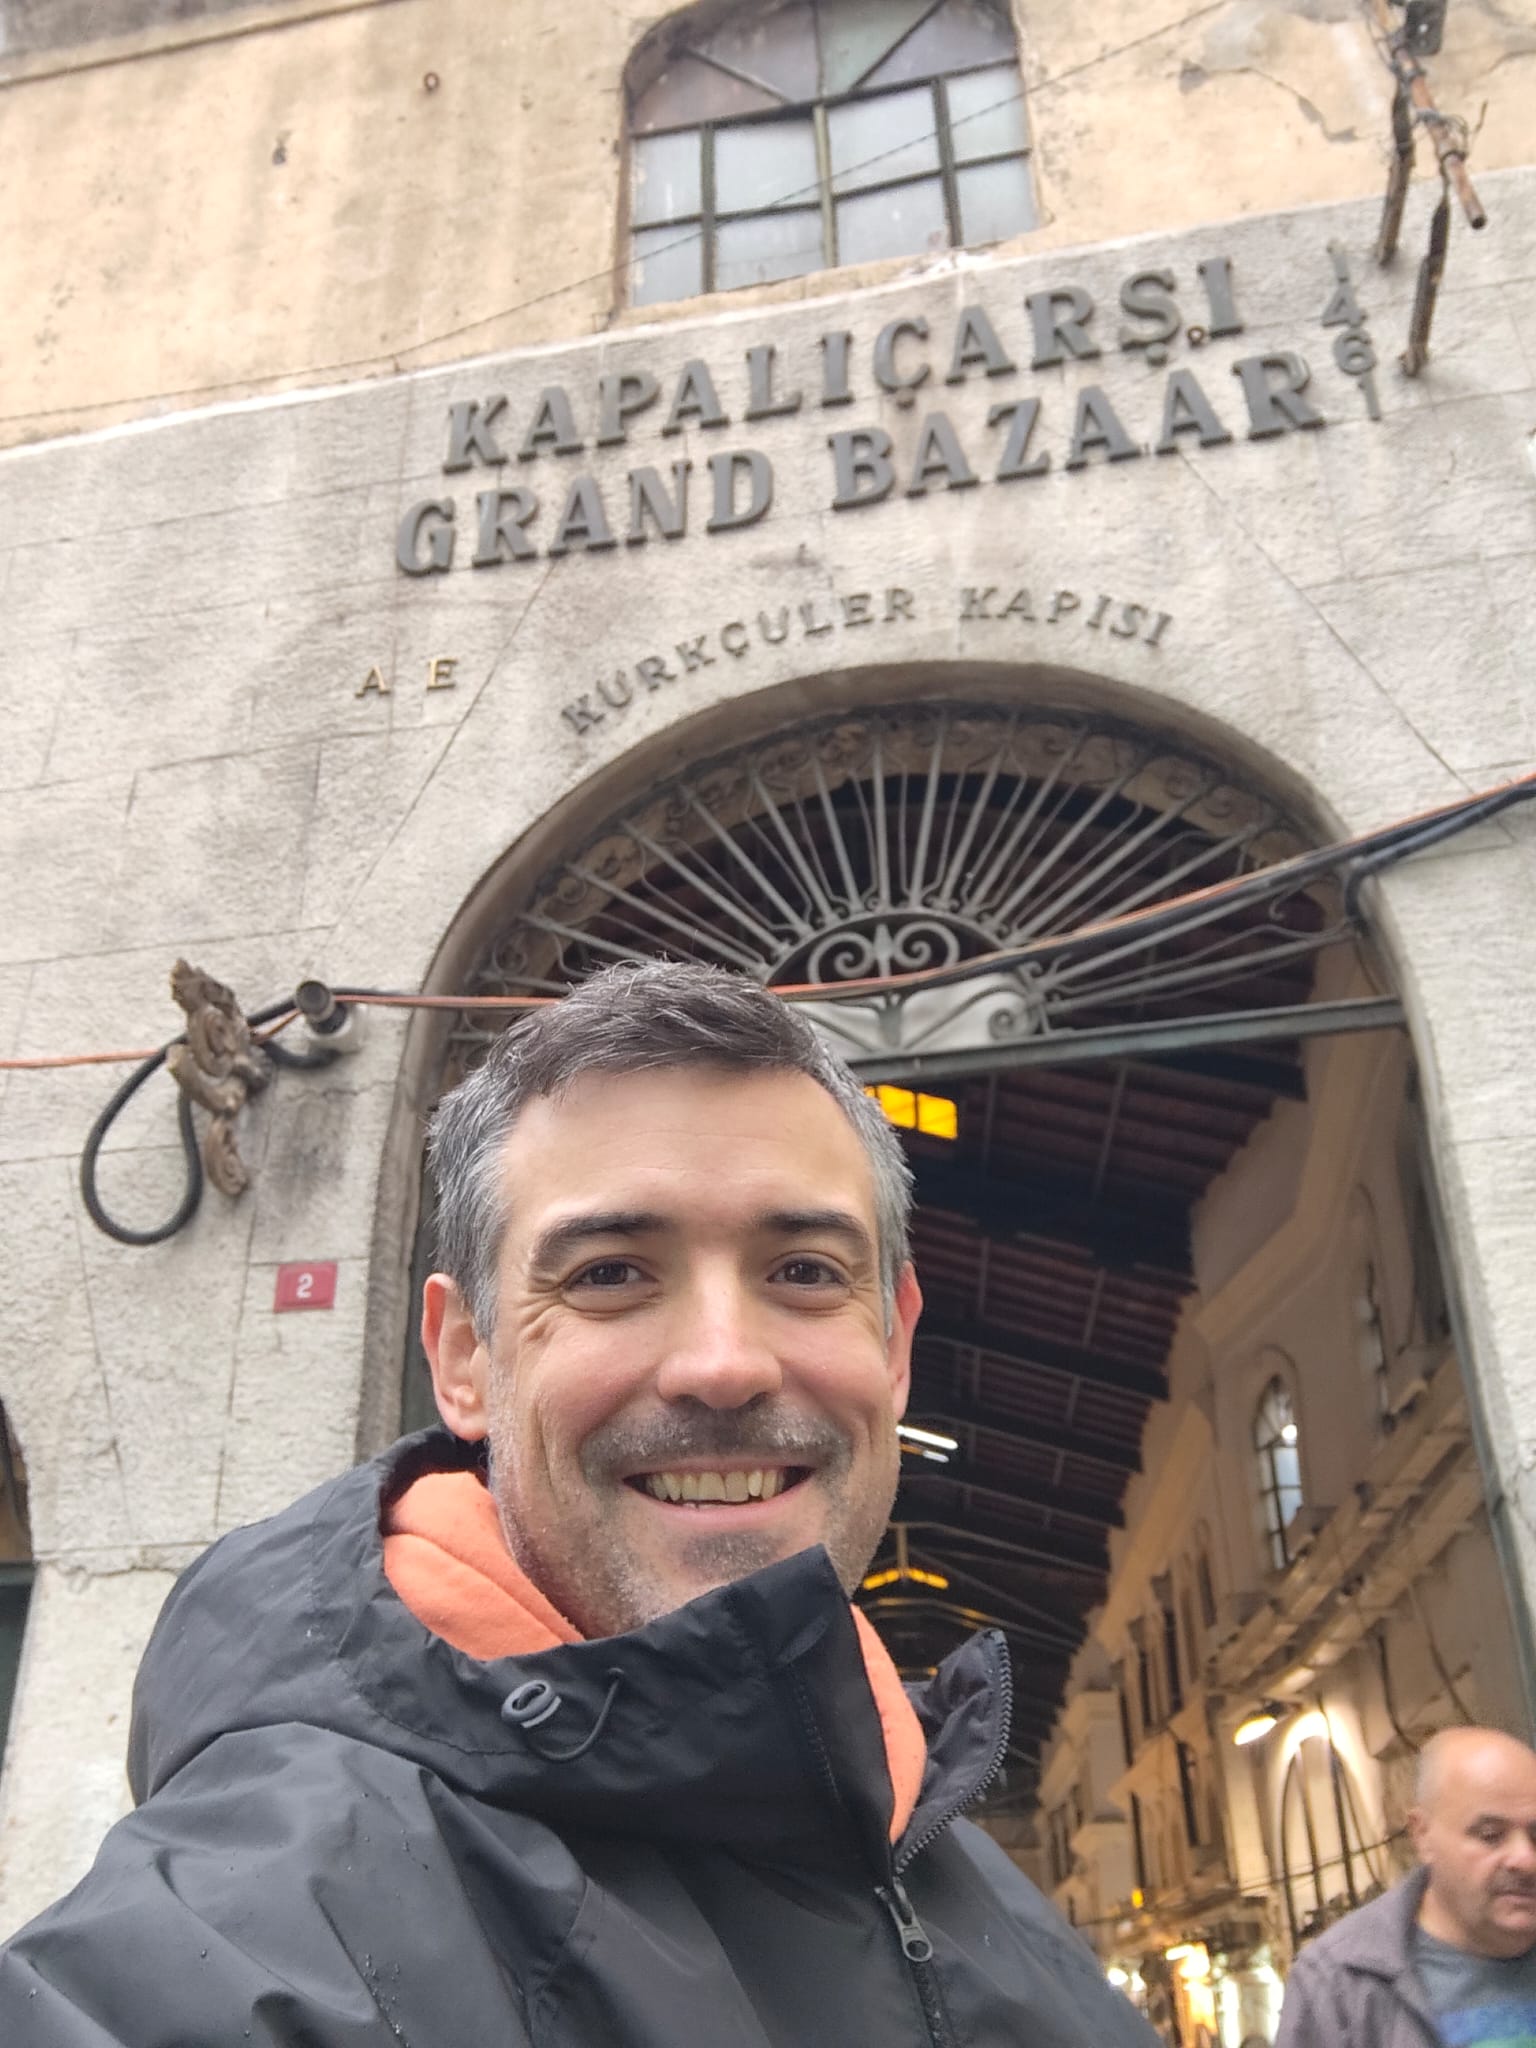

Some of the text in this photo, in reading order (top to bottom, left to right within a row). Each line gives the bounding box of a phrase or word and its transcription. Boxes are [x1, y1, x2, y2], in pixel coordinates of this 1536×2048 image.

[443, 256, 1245, 474] KAPALIÇARŞI
[397, 350, 1326, 578] GRAND BAZAAR
[959, 586, 1173, 648] KAPISI
[296, 1272, 314, 1299] 2
